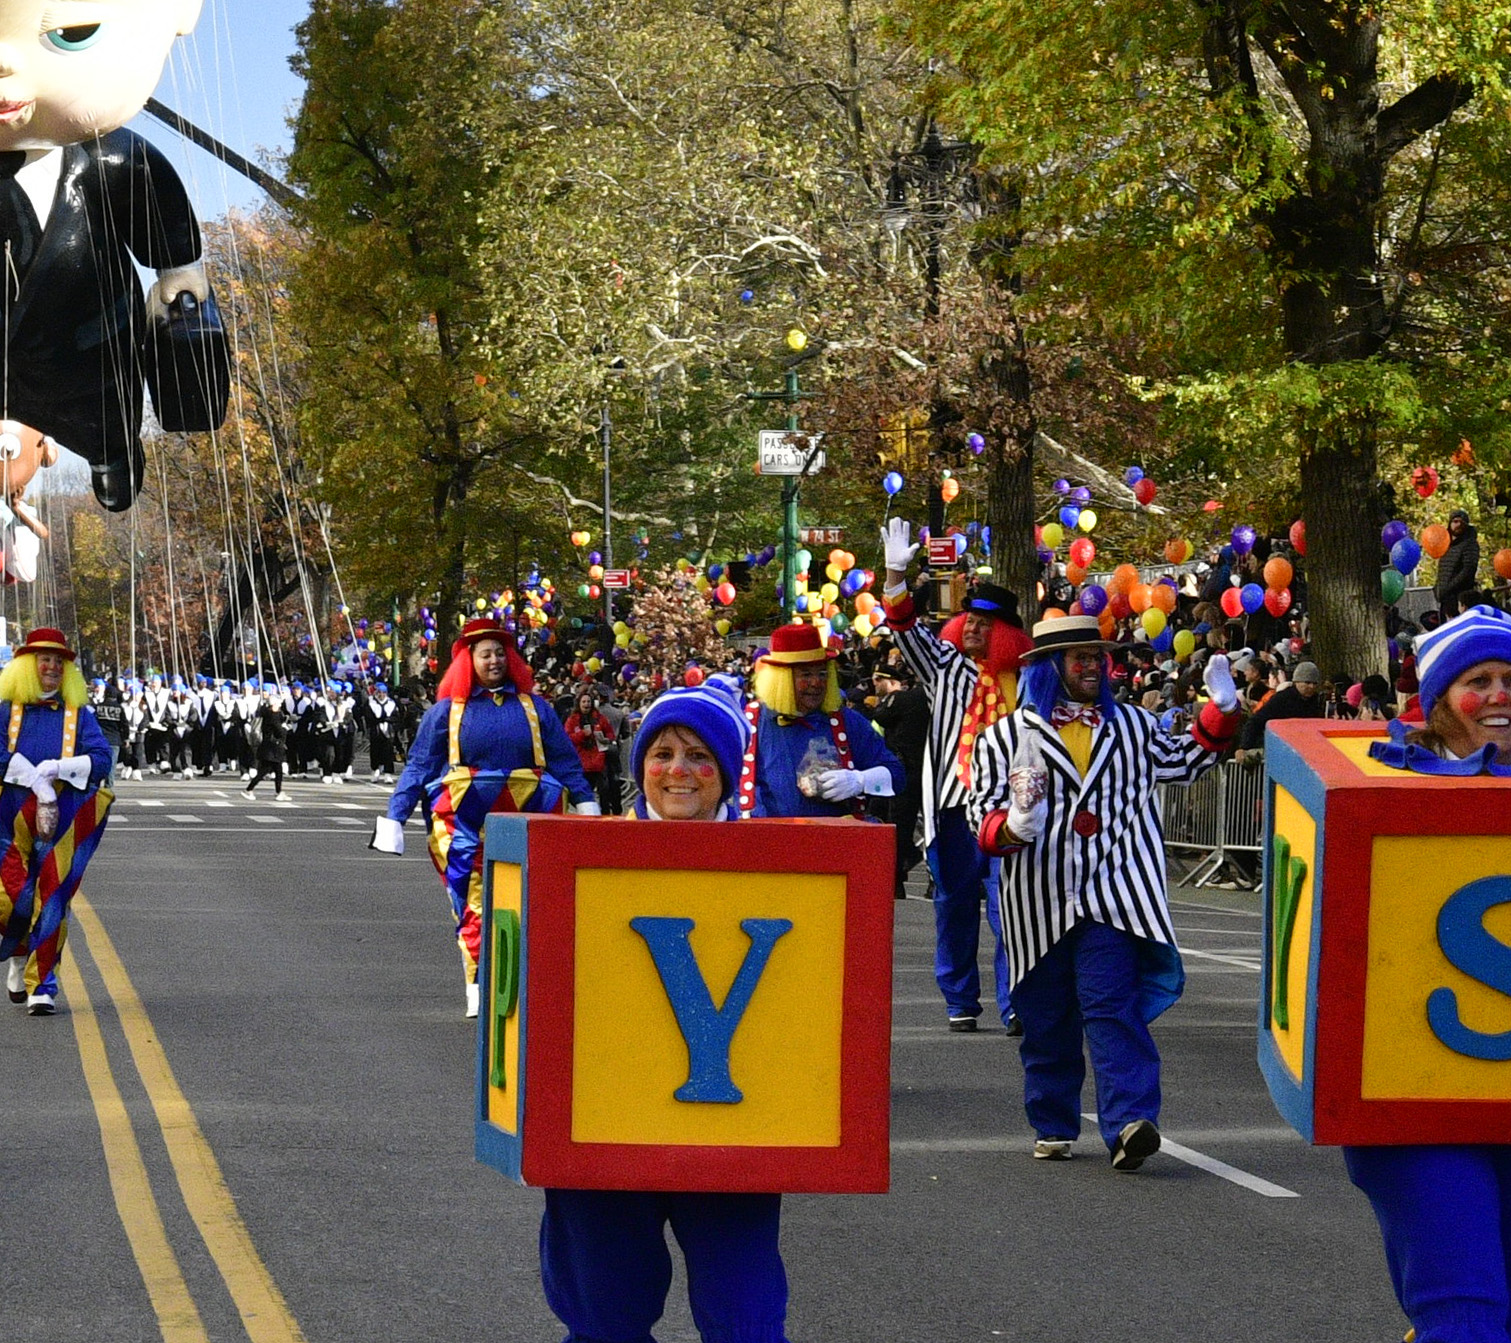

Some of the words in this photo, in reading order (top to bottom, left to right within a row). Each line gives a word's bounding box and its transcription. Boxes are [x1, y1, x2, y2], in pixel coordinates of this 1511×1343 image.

[764, 454, 789, 466] CARS
[490, 908, 520, 1089] P
[629, 915, 794, 1105] Y
